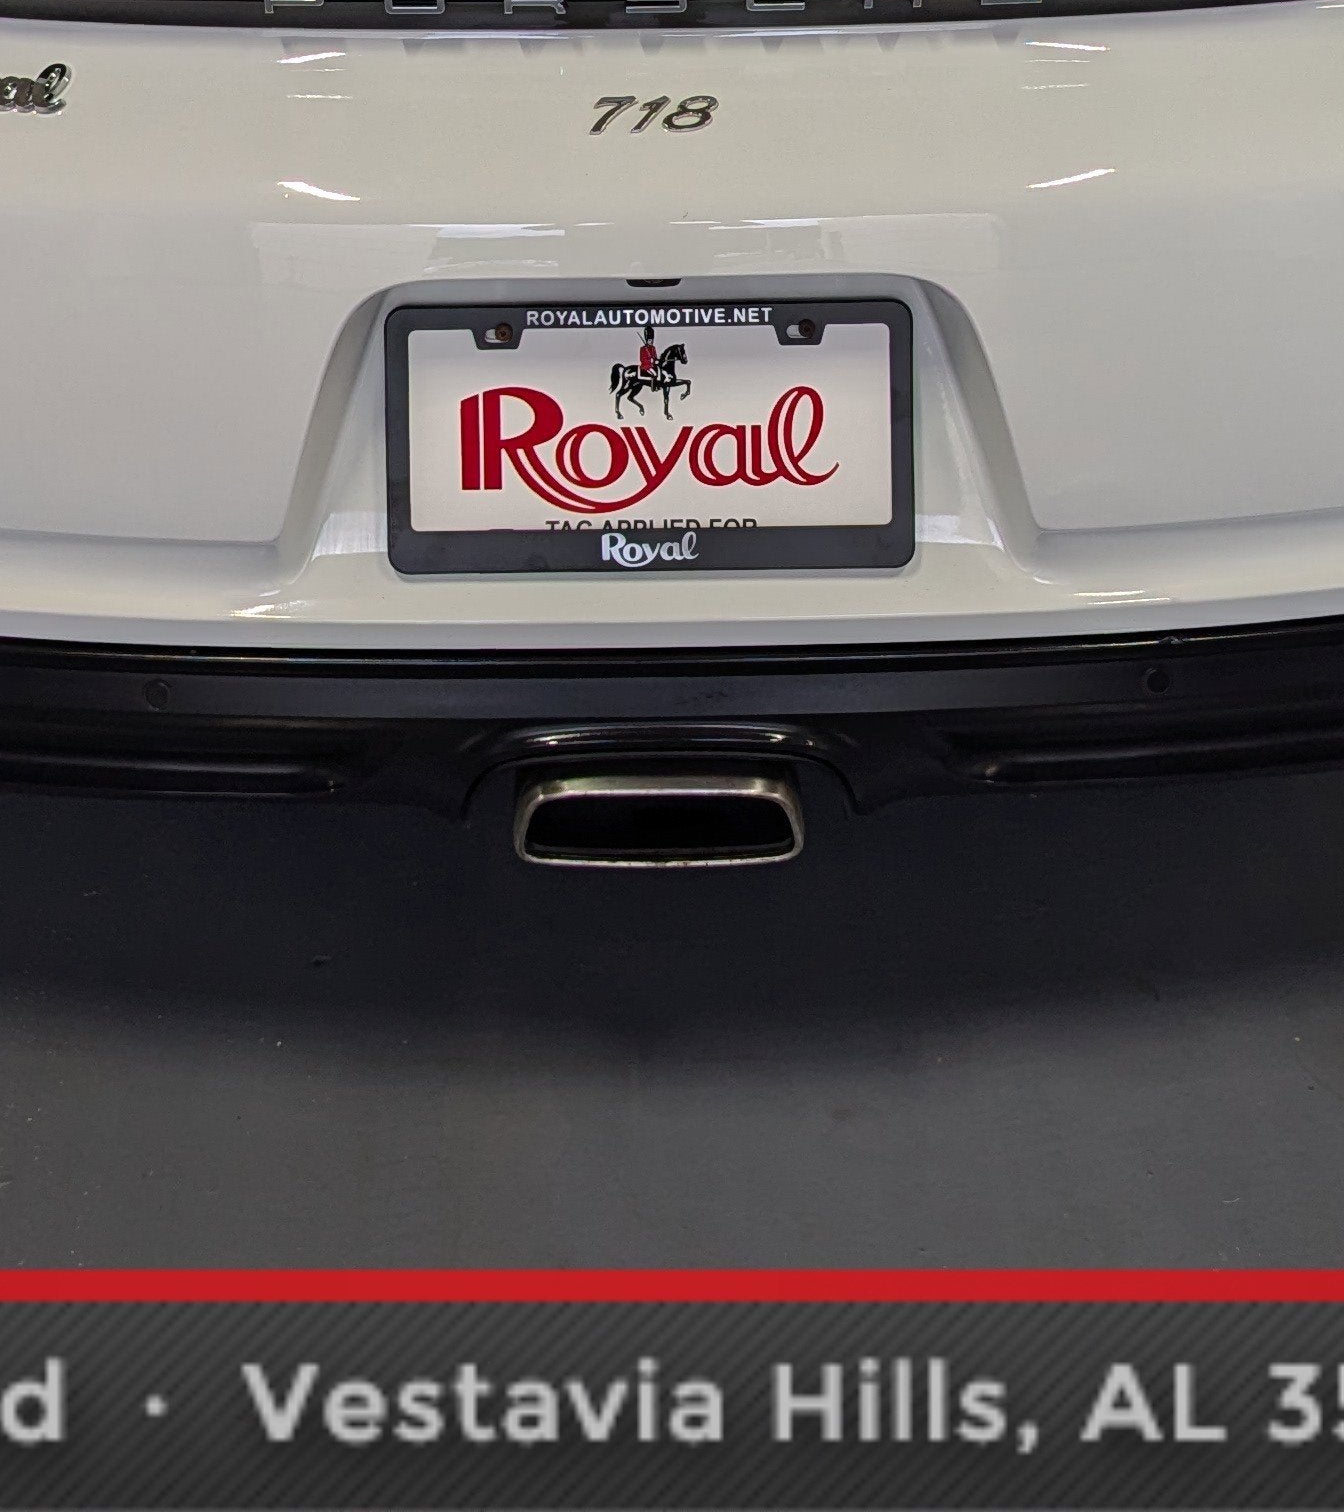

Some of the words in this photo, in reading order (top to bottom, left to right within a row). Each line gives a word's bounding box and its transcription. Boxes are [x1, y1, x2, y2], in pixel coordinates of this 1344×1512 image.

[588, 94, 719, 136] 718
[526, 307, 773, 326] ROYALAUTOMOTIVE.NET
[460, 386, 840, 513] Royal
[601, 531, 699, 568] Royal
